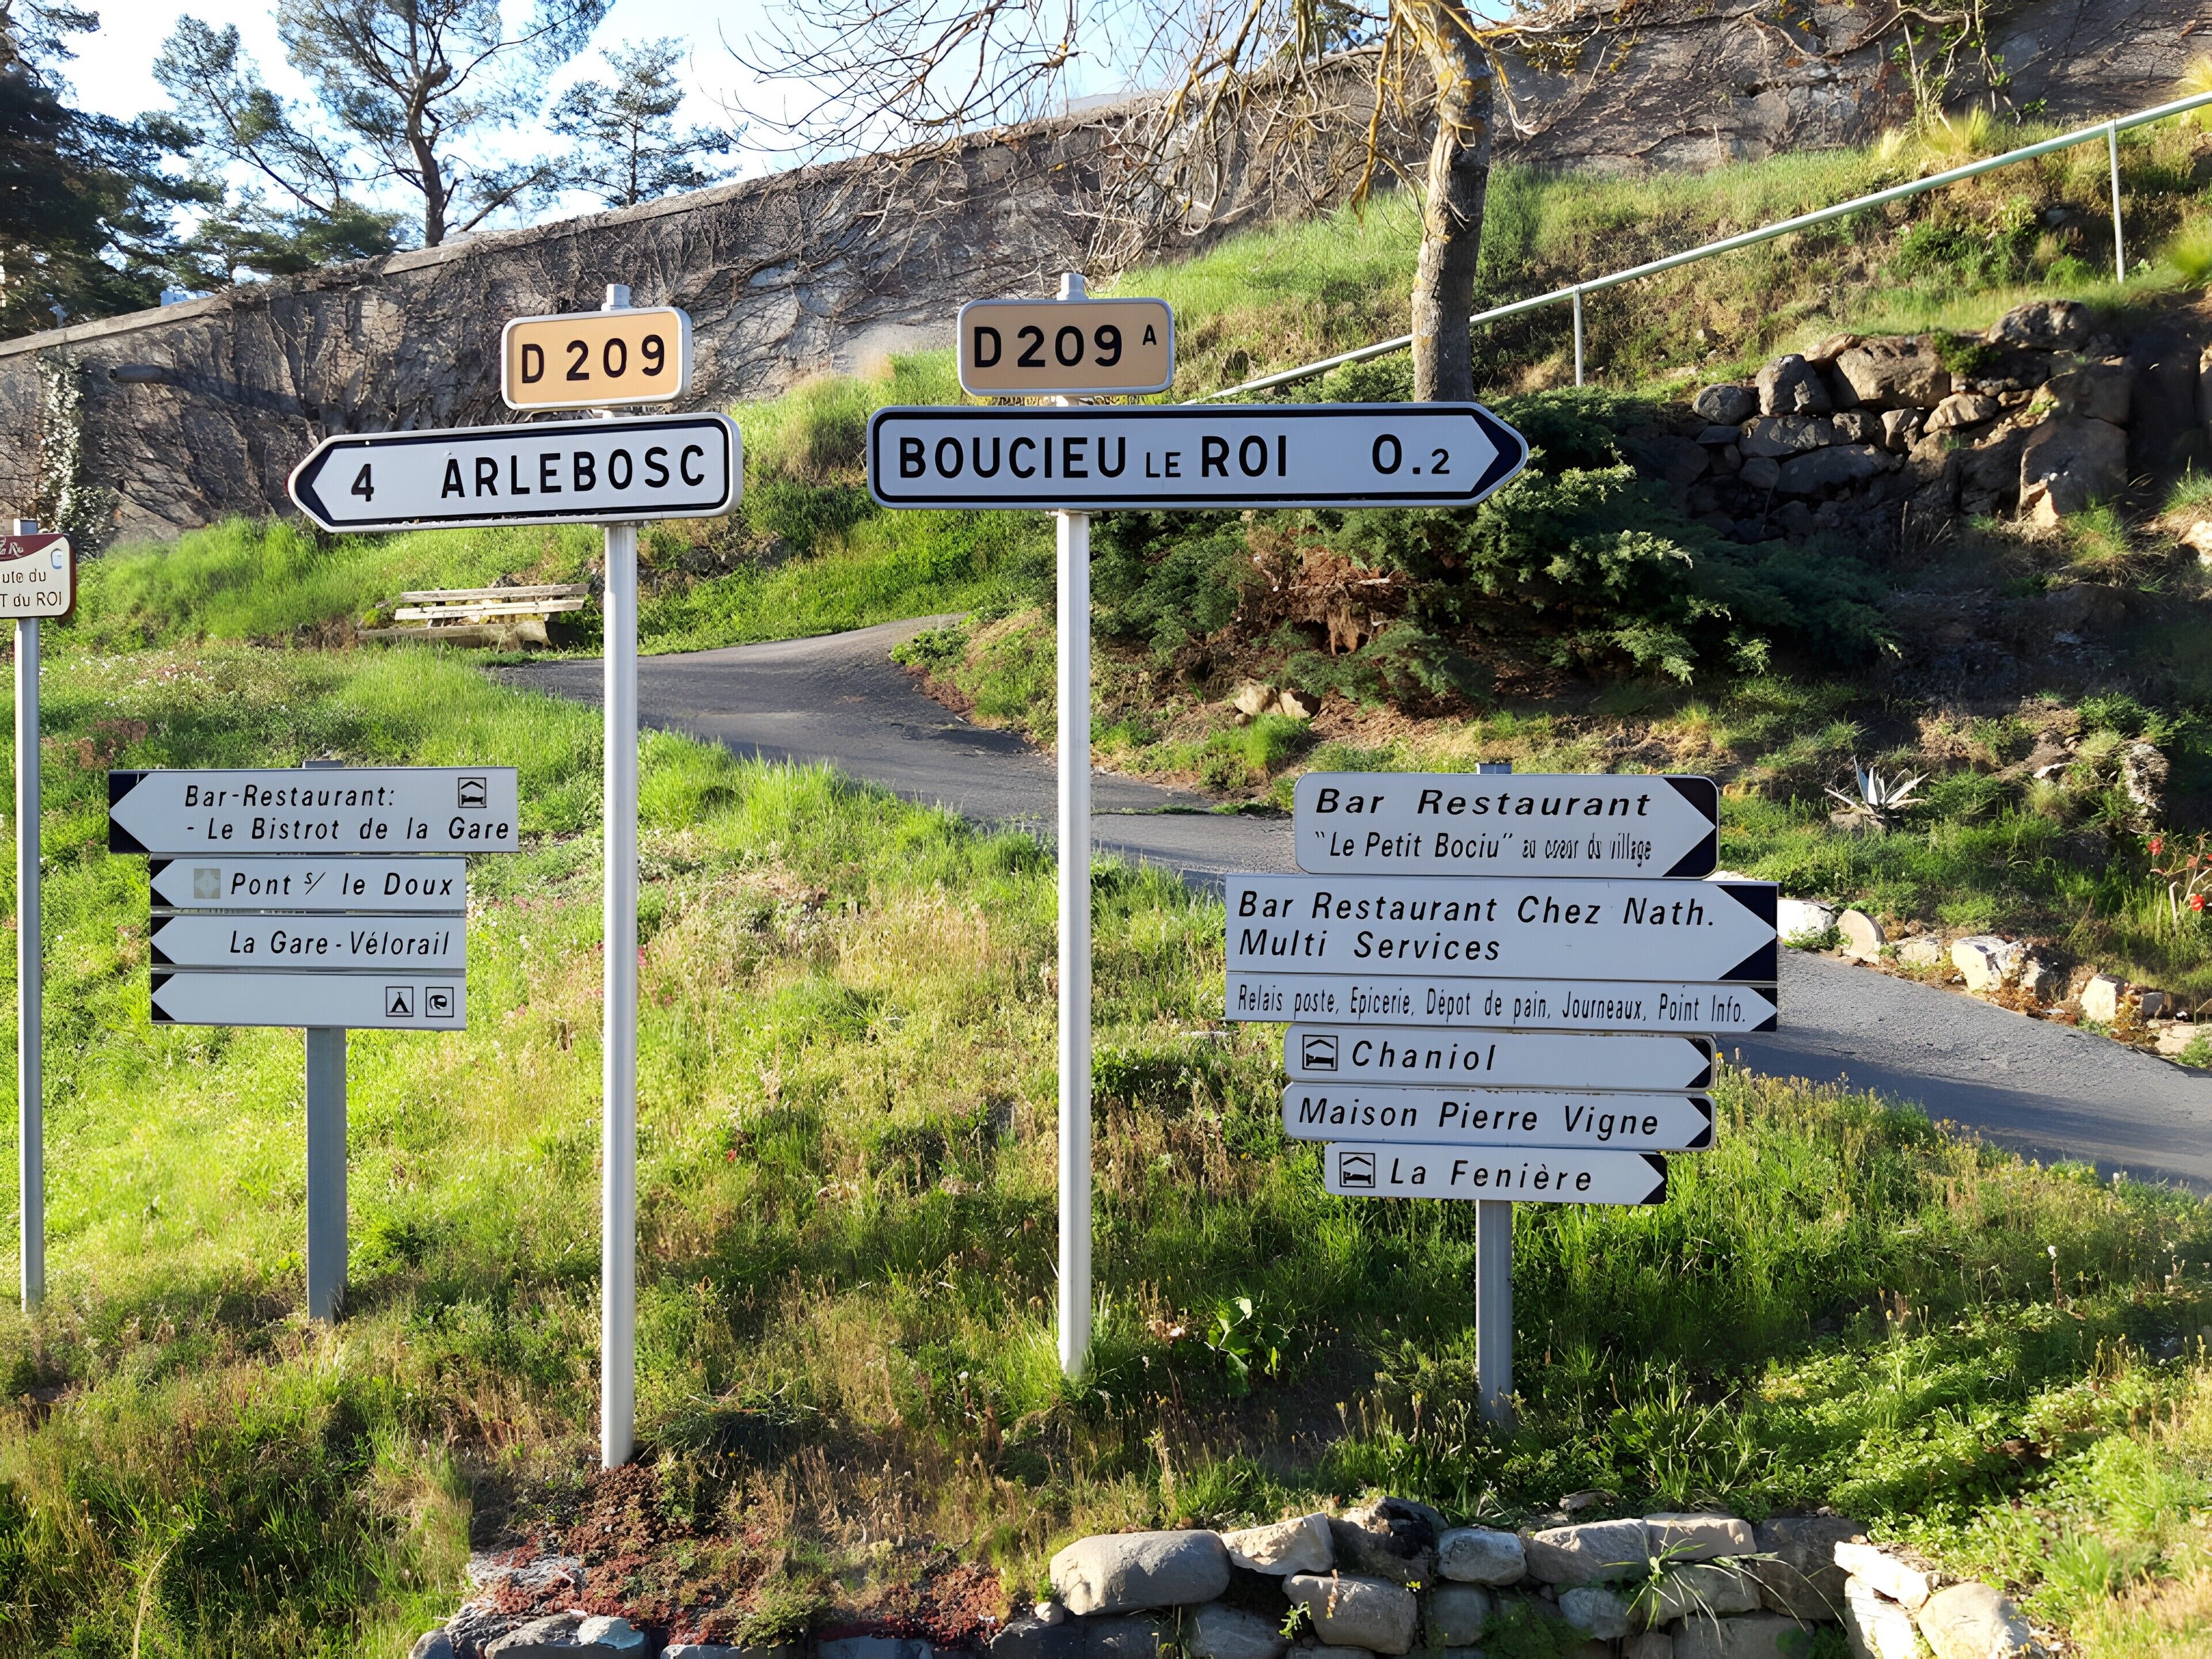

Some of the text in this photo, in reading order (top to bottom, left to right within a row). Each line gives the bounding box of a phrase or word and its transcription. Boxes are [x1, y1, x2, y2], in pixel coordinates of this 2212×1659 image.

[521, 334, 665, 384] D 209
[974, 324, 1157, 368] D 209 A
[351, 444, 704, 502] 4 ARLEBOSC
[900, 437, 1126, 479] BOUCIEU
[1146, 452, 1181, 478] LE
[1202, 435, 1286, 478] ROI
[29, 568, 46, 582] du
[13, 593, 31, 607] du
[36, 591, 62, 606] ROI
[185, 784, 394, 807] Bar-Restaurant:
[1316, 788, 1651, 816] Bar Restaurant
[207, 817, 233, 840] Le
[251, 817, 339, 840] Bistrot
[359, 817, 388, 839] de
[407, 817, 428, 839] la
[448, 816, 509, 839] Gare
[1365, 832, 1422, 857] Petit
[1588, 832, 1602, 859] du
[1609, 832, 1652, 868] village
[230, 872, 291, 895] Pont
[342, 873, 365, 895] le
[384, 872, 453, 895] Doux
[1238, 891, 1713, 926] Bar Restaurant Chez Nath.
[230, 930, 255, 953] La
[1239, 929, 1499, 961] Multi Services
[1238, 984, 1283, 1012] Relais
[1294, 989, 1339, 1020] poste,
[1426, 988, 1471, 1022] Dépot
[1484, 989, 1502, 1016] de
[1514, 990, 1550, 1024] pain,
[1562, 991, 1646, 1021] Journeaux,
[1658, 993, 1699, 1021] Point
[1711, 995, 1745, 1022] Info.
[1352, 1040, 1496, 1070] Chaniol
[1299, 1097, 1658, 1141] Maison Pierre Vigne
[1390, 1158, 1591, 1191] La Fenière
